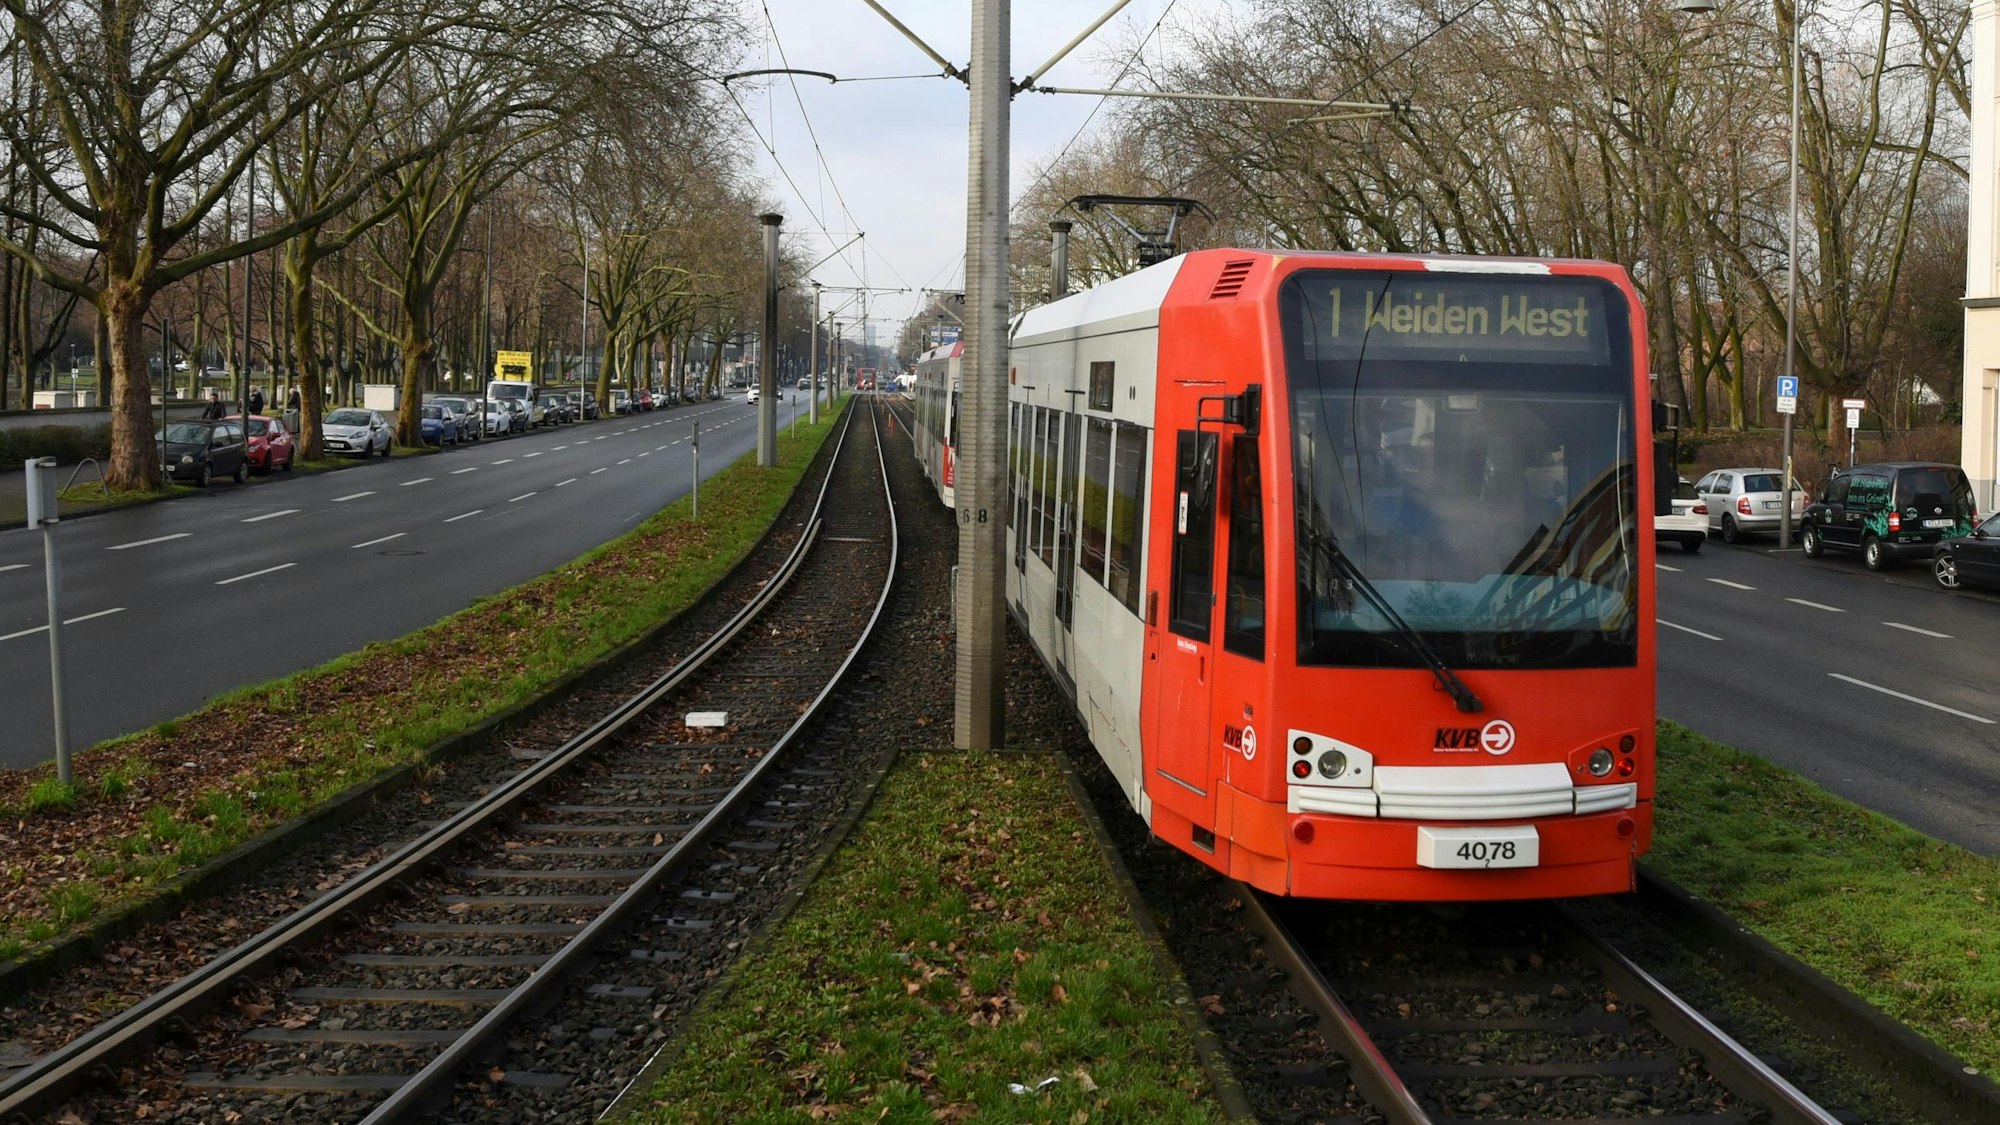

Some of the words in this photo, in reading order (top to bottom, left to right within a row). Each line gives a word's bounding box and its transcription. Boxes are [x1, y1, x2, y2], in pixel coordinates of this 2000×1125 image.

[1329, 287, 1341, 338] 1
[1364, 290, 1488, 336] Weiden
[1500, 294, 1589, 338] West
[1223, 724, 1243, 748] KVB
[1434, 728, 1481, 748] KVB
[1456, 841, 1516, 861] 4078
